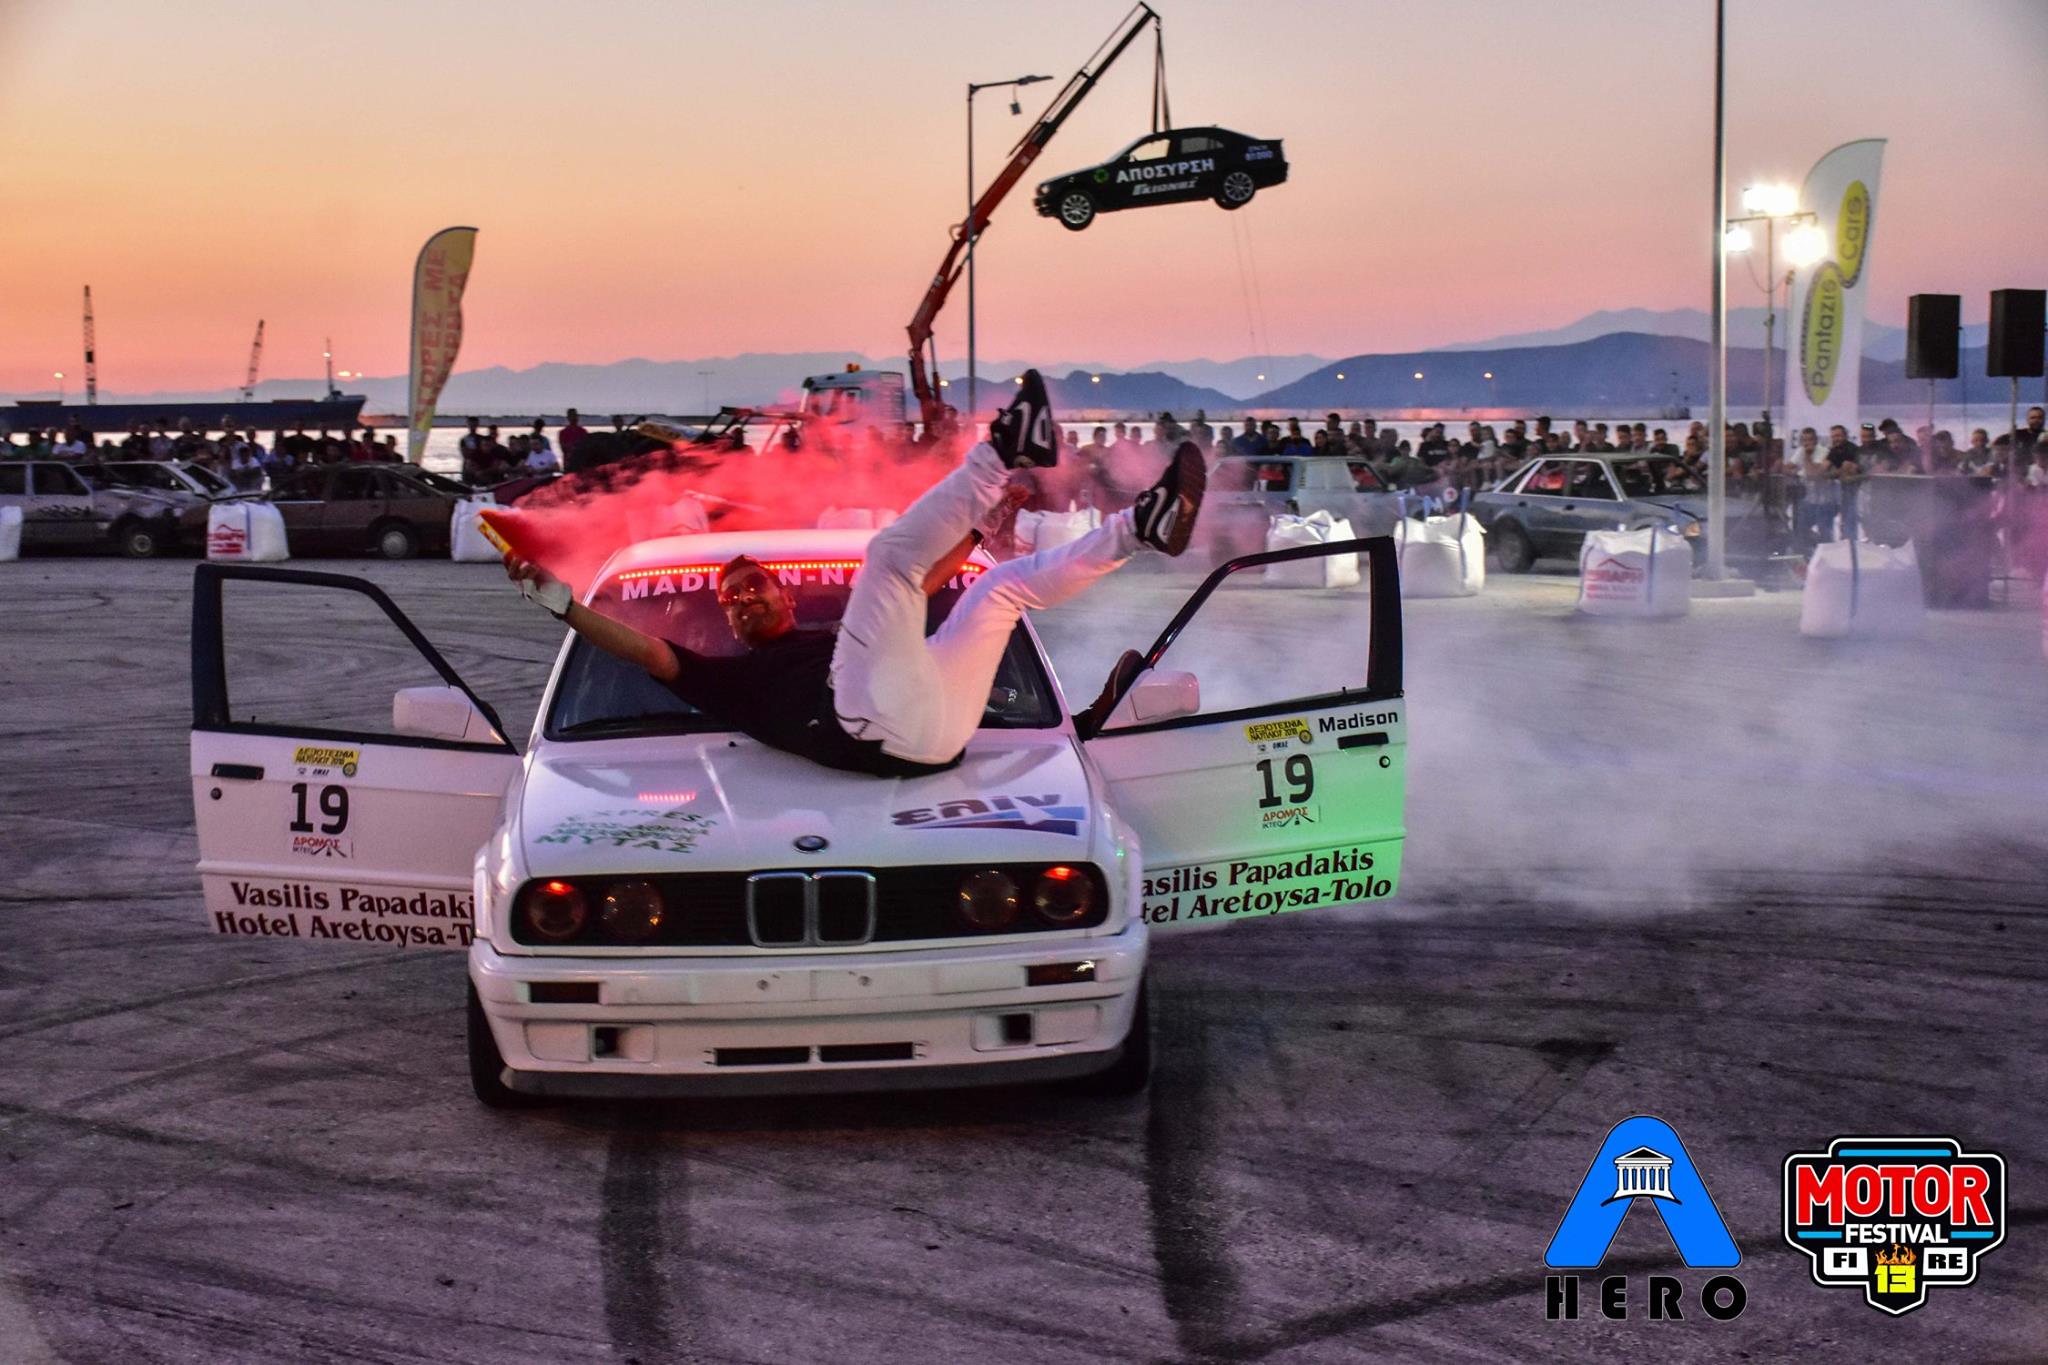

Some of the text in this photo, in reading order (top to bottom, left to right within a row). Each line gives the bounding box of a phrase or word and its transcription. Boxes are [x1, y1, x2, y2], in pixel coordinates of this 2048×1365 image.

[1116, 158, 1214, 183] ΑΠΟΣΥΡΣΗ
[1811, 196, 1861, 388] Pantazis Cars
[1318, 712, 1398, 733] Madison
[1256, 754, 1315, 808] 19
[290, 782, 350, 835] 19
[1142, 848, 1374, 897] asilis Papadakis
[230, 882, 474, 918] Vasilis Papadaki
[1140, 875, 1392, 924] tel Aretoysa-Tolo
[215, 911, 474, 948] Hotel Aretoysa-T
